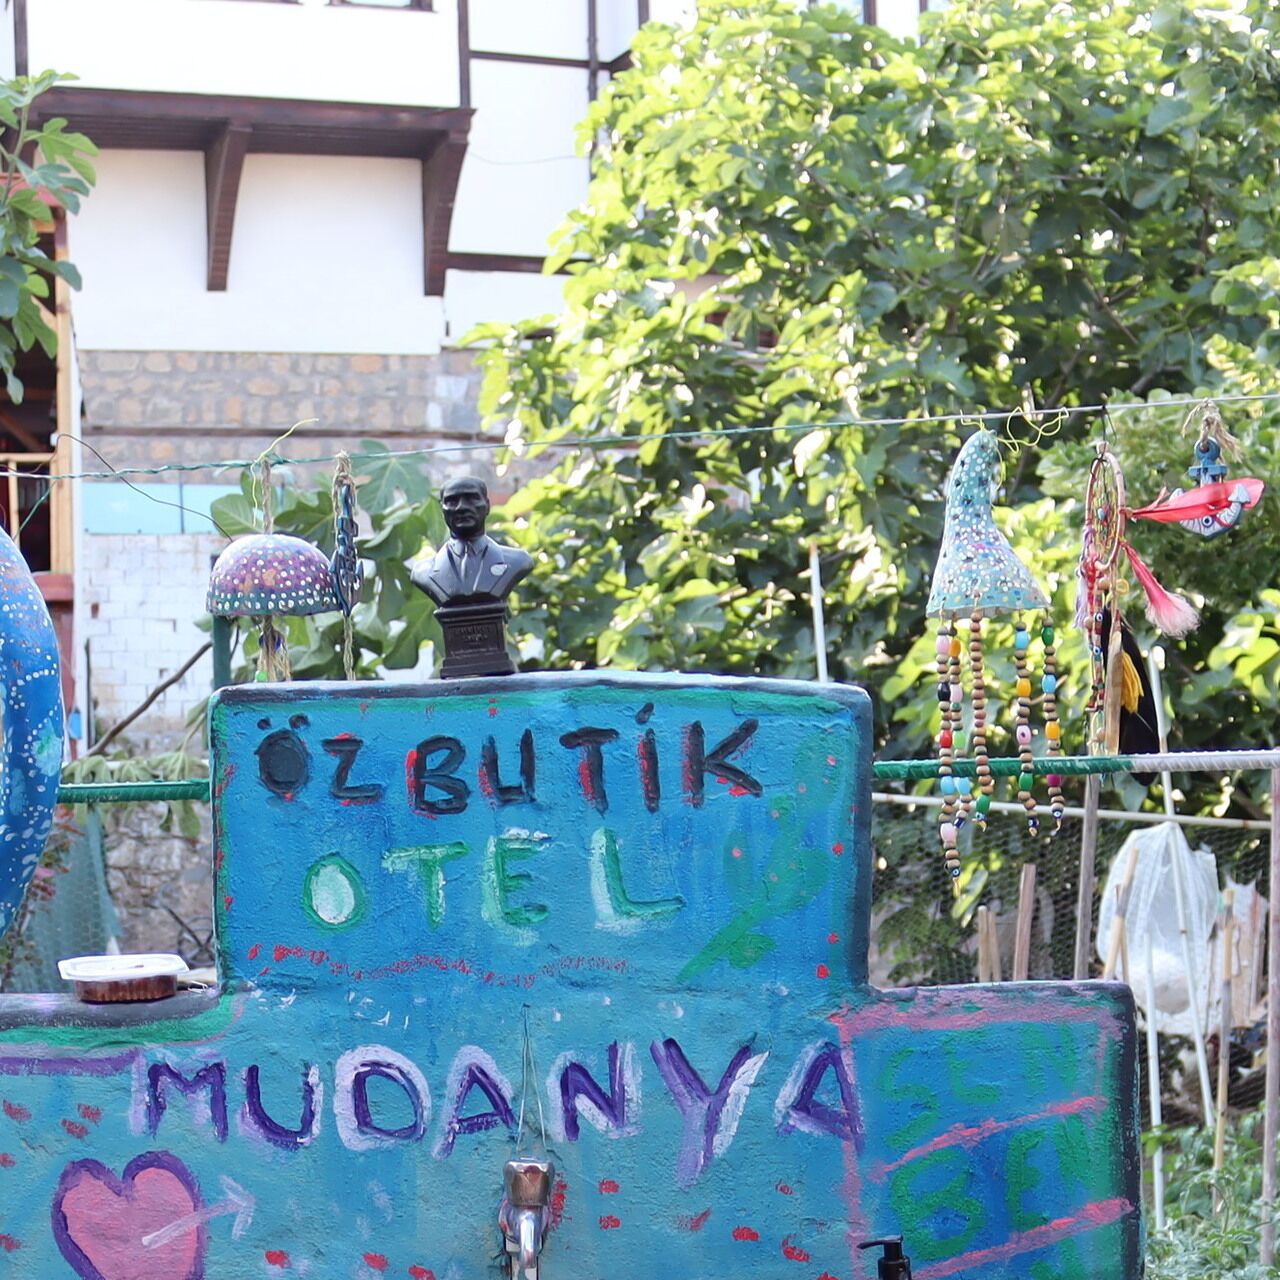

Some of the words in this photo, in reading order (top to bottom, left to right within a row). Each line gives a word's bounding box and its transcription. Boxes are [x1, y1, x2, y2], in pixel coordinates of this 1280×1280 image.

[255, 714, 382, 805] ÖZ
[404, 702, 762, 818] BUTİK
[302, 826, 686, 945] OTEL
[131, 1034, 866, 1188] MUDANYA
[876, 1020, 1080, 1148] SEN
